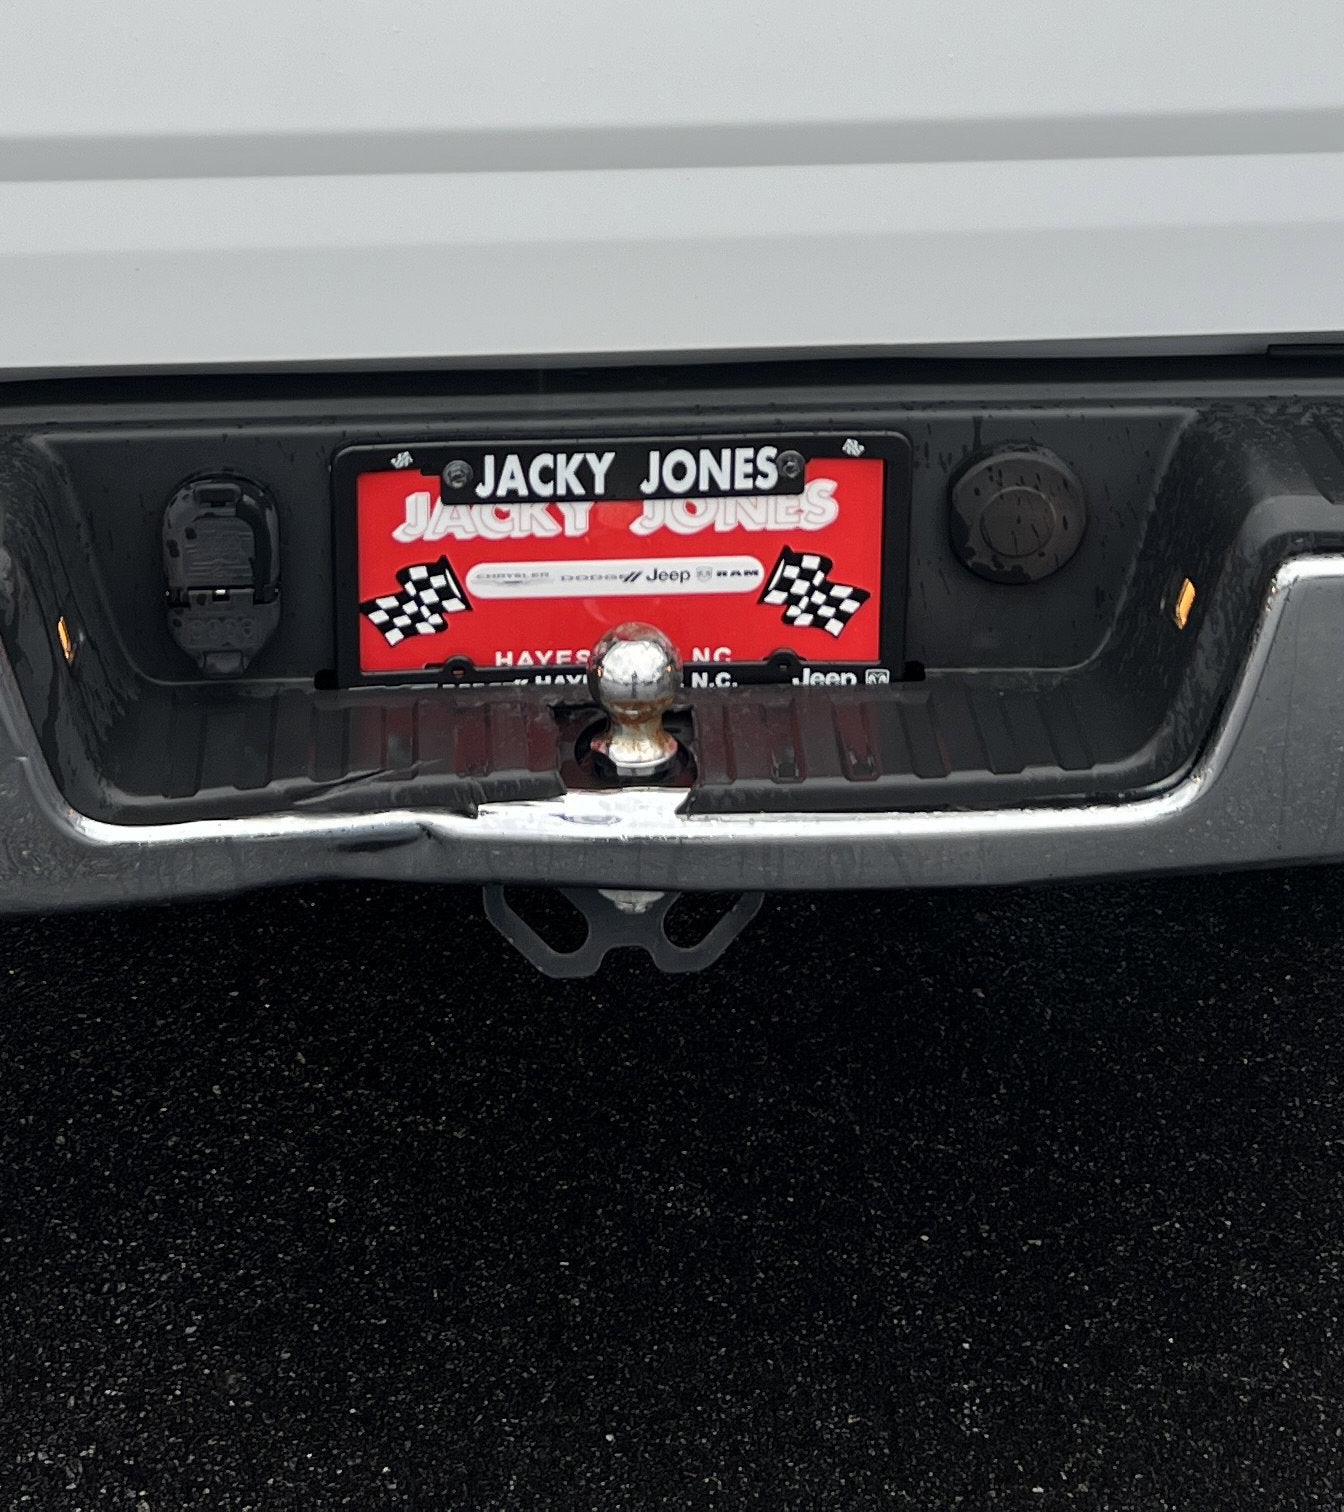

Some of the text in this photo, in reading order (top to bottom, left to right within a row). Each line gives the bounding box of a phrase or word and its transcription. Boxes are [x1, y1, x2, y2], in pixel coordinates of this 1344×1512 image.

[475, 446, 778, 498] JACKY JONES
[646, 568, 691, 583] Jeep
[716, 568, 760, 578] RAM
[495, 647, 732, 666] HAYES NC
